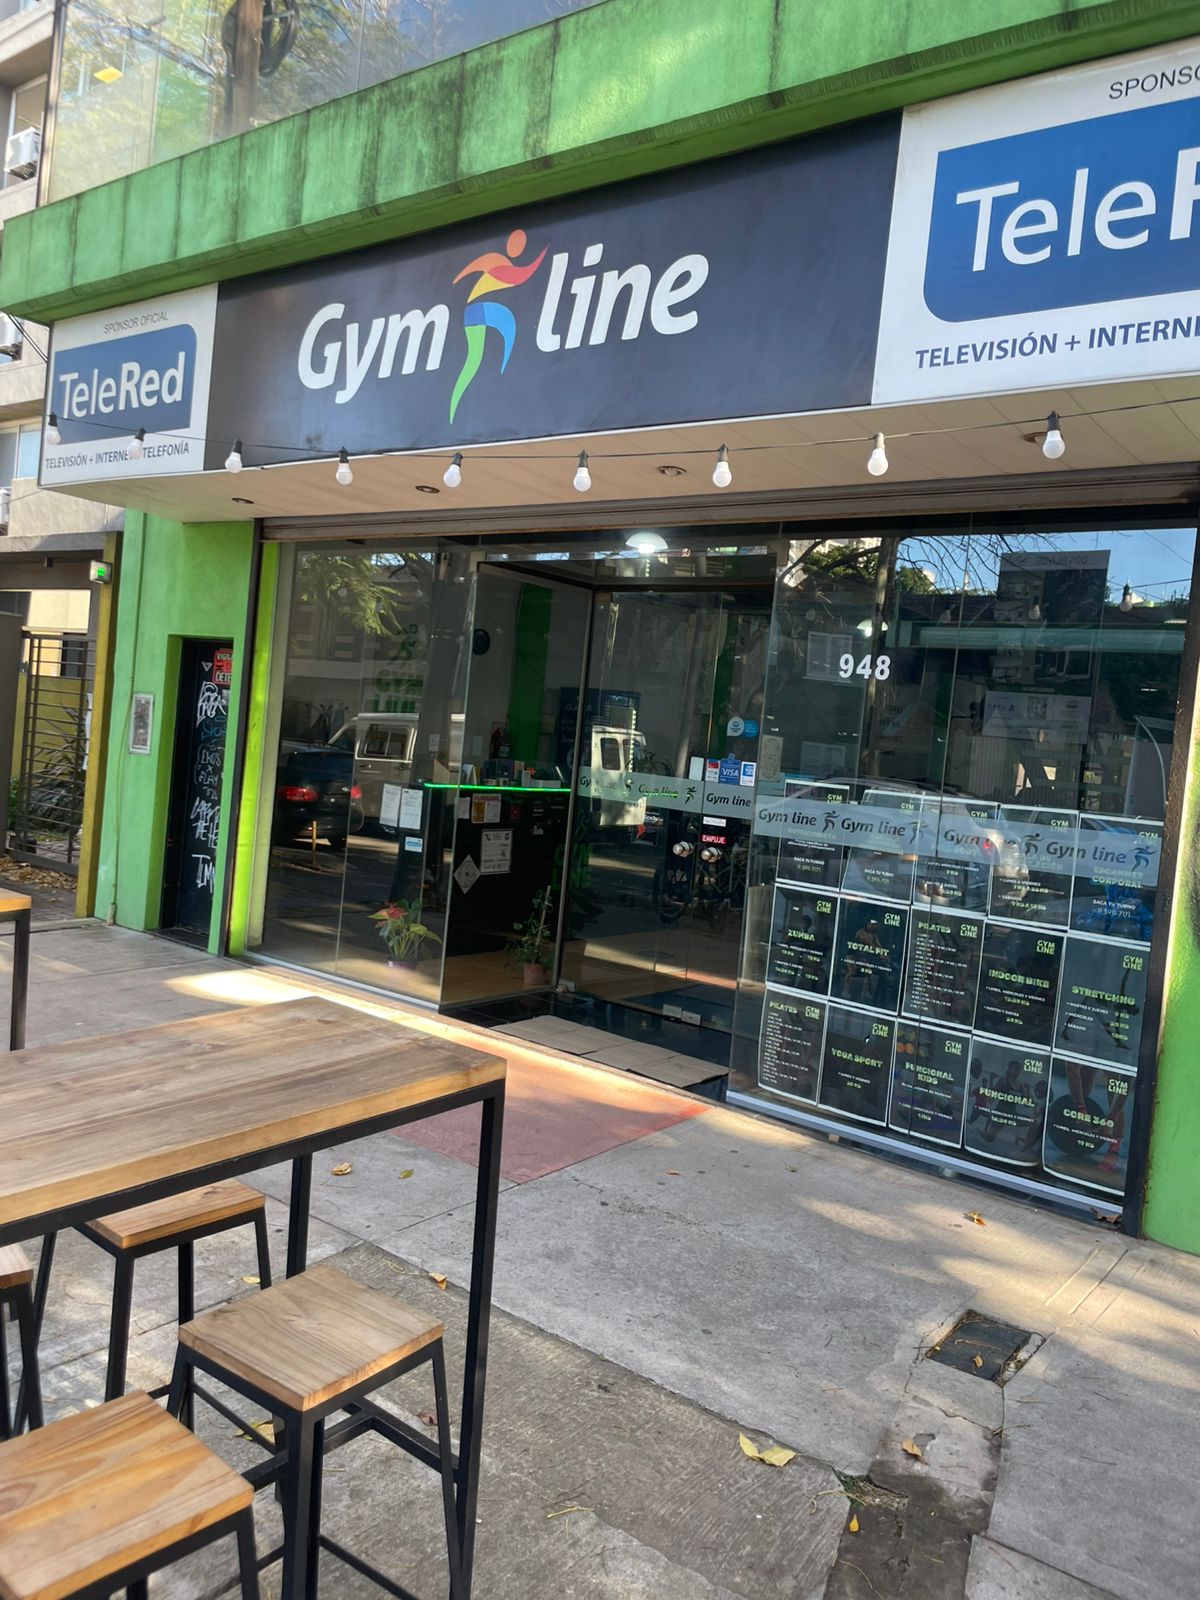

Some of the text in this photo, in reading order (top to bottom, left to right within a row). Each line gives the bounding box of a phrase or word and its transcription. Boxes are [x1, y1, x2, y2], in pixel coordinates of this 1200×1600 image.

[104, 309, 169, 334] SPONSOR OFICIAL
[298, 243, 709, 404] Gym line
[915, 332, 1058, 369] TELEVISIÓN
[1064, 334, 1081, 352] +
[58, 351, 186, 418] TeleRed
[45, 454, 88, 469] TELEVISIÓN
[95, 447, 139, 464] INTERNE
[143, 442, 190, 459] TELEFONÍA
[839, 654, 891, 680] 948
[722, 768, 739, 776] VISA
[706, 792, 752, 807] Gym line
[758, 807, 817, 826] Gym line
[841, 818, 873, 834] Gym
[878, 821, 906, 836] line
[1046, 841, 1127, 863] Gym line
[787, 929, 816, 942] ZUMBA
[847, 941, 875, 954] TOTAL
[1123, 961, 1143, 971] LINE
[1124, 955, 1143, 964] GYM
[854, 1055, 883, 1068] SPORT
[1024, 1059, 1043, 1068] GYM
[1023, 1065, 1043, 1074] LINE
[918, 1073, 938, 1085] KIDS
[1109, 1079, 1128, 1089] GYM
[979, 1087, 1035, 1107] FUNCIONAL
[1108, 1085, 1128, 1096] LINE
[1063, 1108, 1115, 1128] CORE 360
